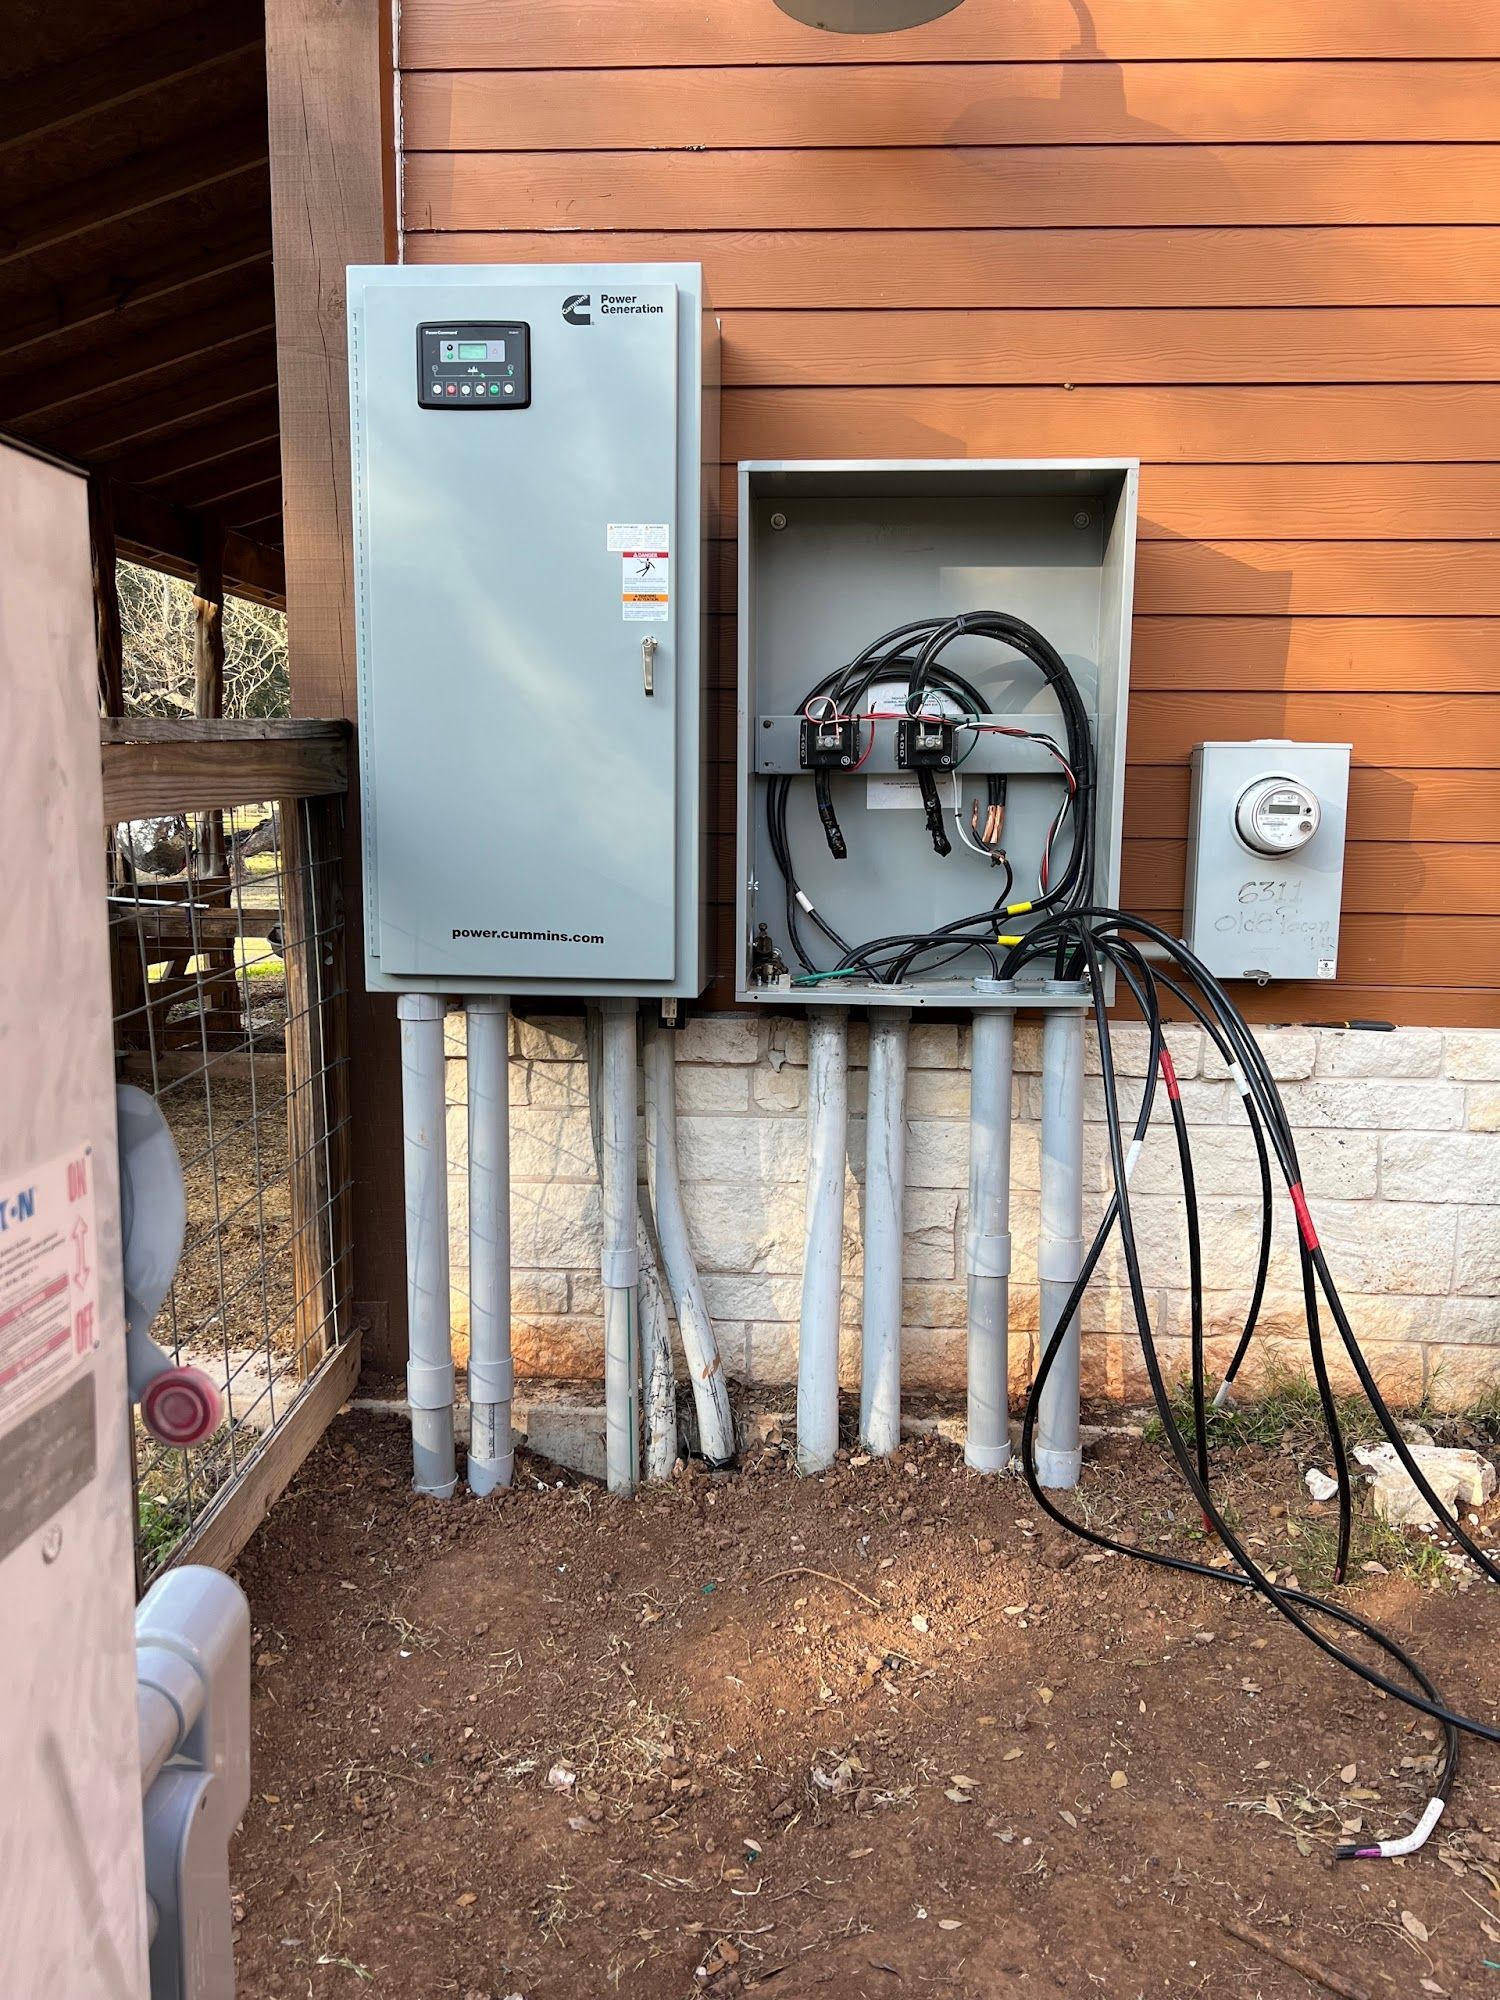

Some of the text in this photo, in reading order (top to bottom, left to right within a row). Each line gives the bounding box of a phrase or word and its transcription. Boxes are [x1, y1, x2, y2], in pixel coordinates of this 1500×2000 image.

[601, 294, 637, 304] Power
[601, 304, 664, 314] Generation
[1238, 881, 1302, 904] 6311
[452, 929, 605, 944] power.cummins.com
[67, 1157, 88, 1203] ON
[75, 1300, 95, 1354] OFF
